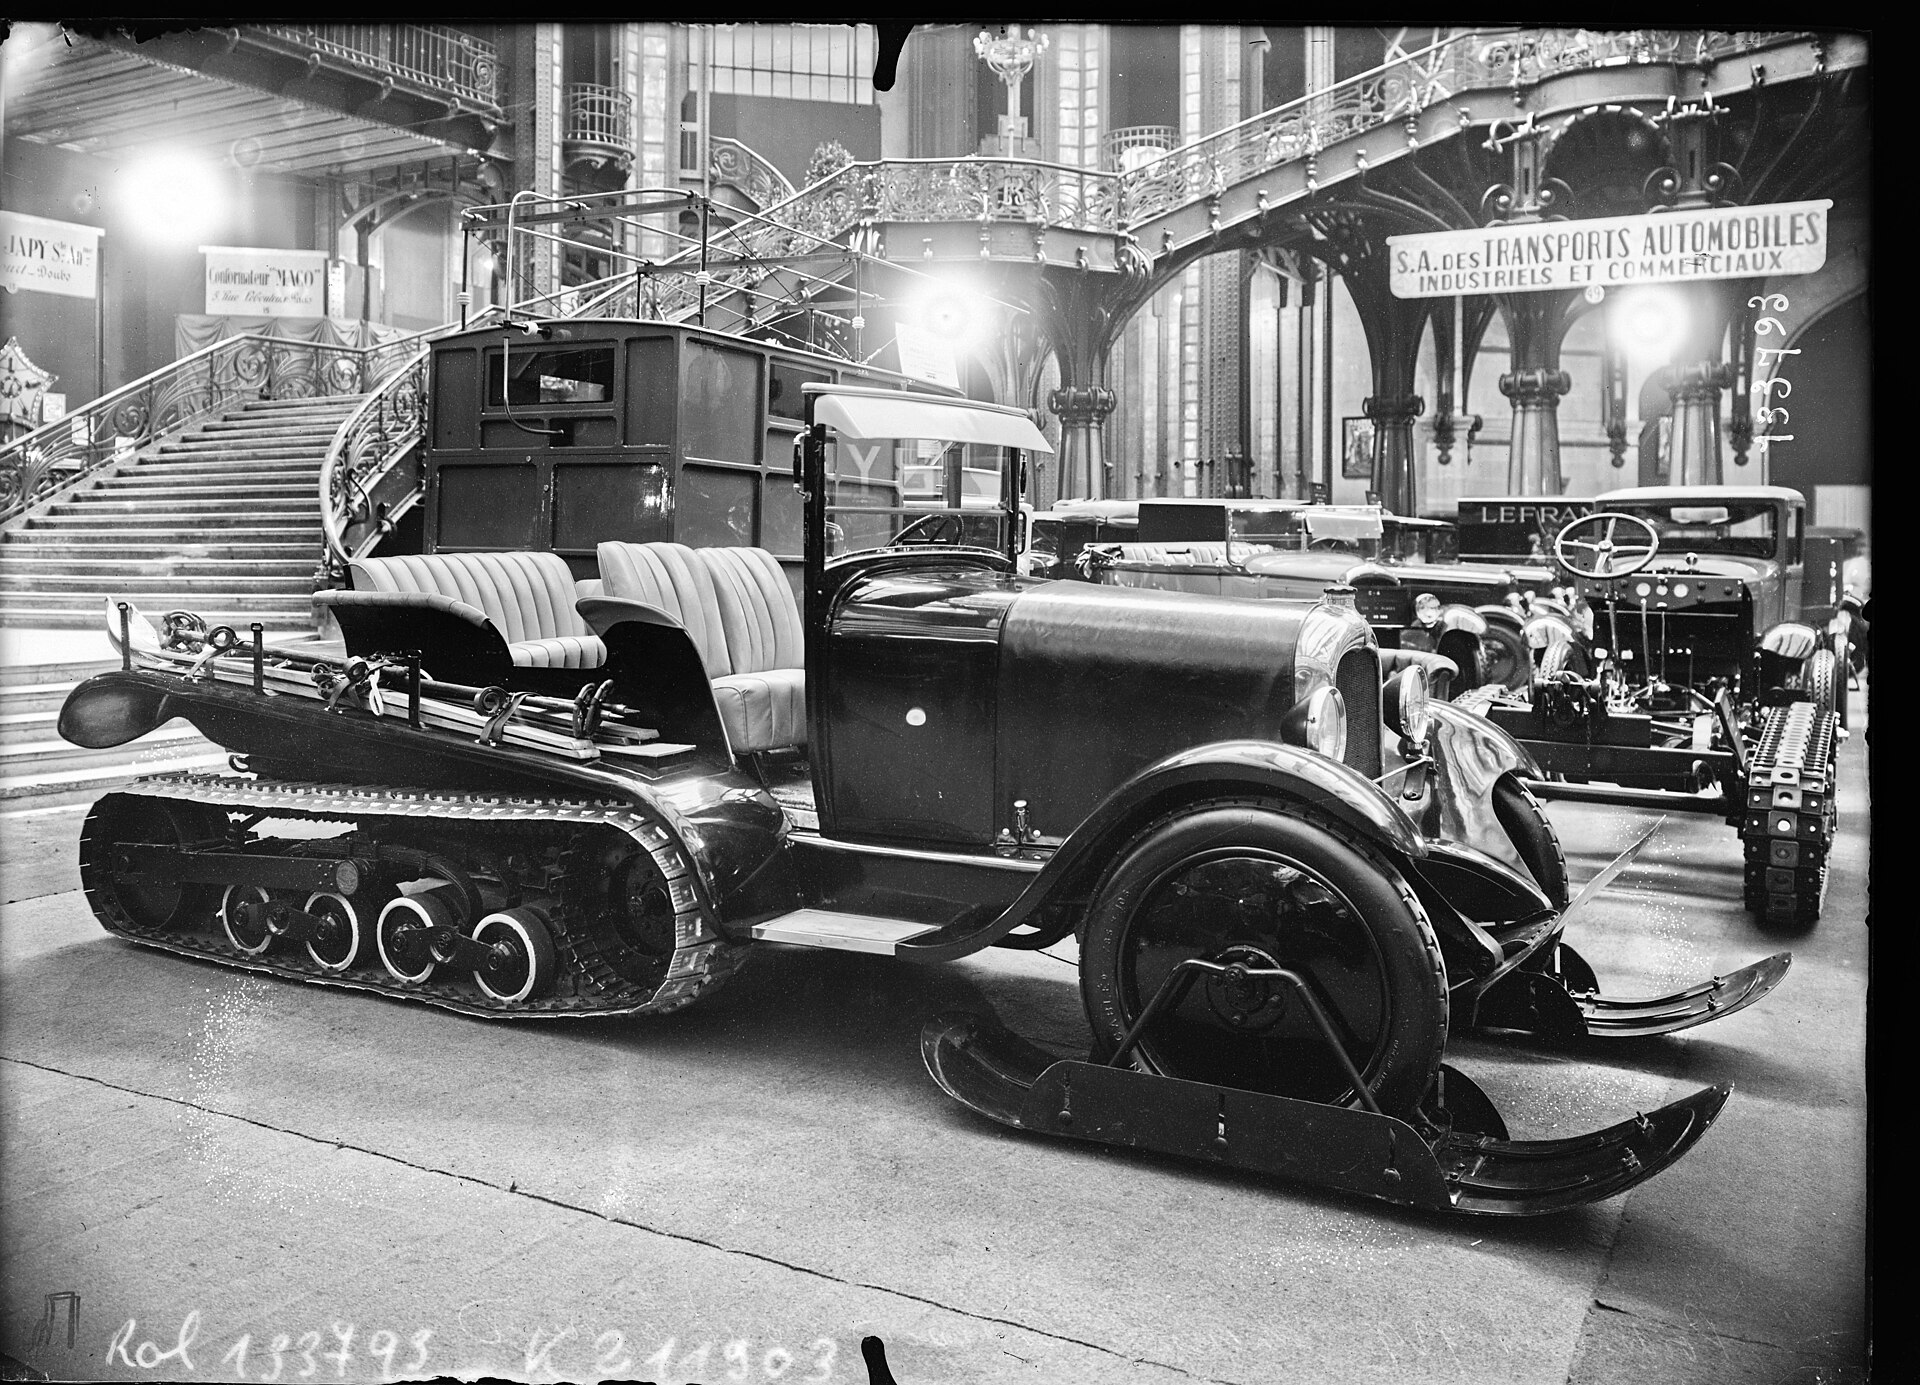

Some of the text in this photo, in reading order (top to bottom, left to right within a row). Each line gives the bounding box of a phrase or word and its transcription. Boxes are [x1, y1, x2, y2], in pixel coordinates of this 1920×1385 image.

[3, 234, 48, 260] JAPY
[1442, 251, 1480, 271] DES
[1484, 227, 1631, 268] TRANSPORTS
[1643, 211, 1820, 257] AUTOMOBILES
[208, 268, 270, 287] Conformateur
[1418, 250, 1783, 293] INDUSTRIELS ET COMMERCIAUX
[1586, 286, 1603, 301] 49
